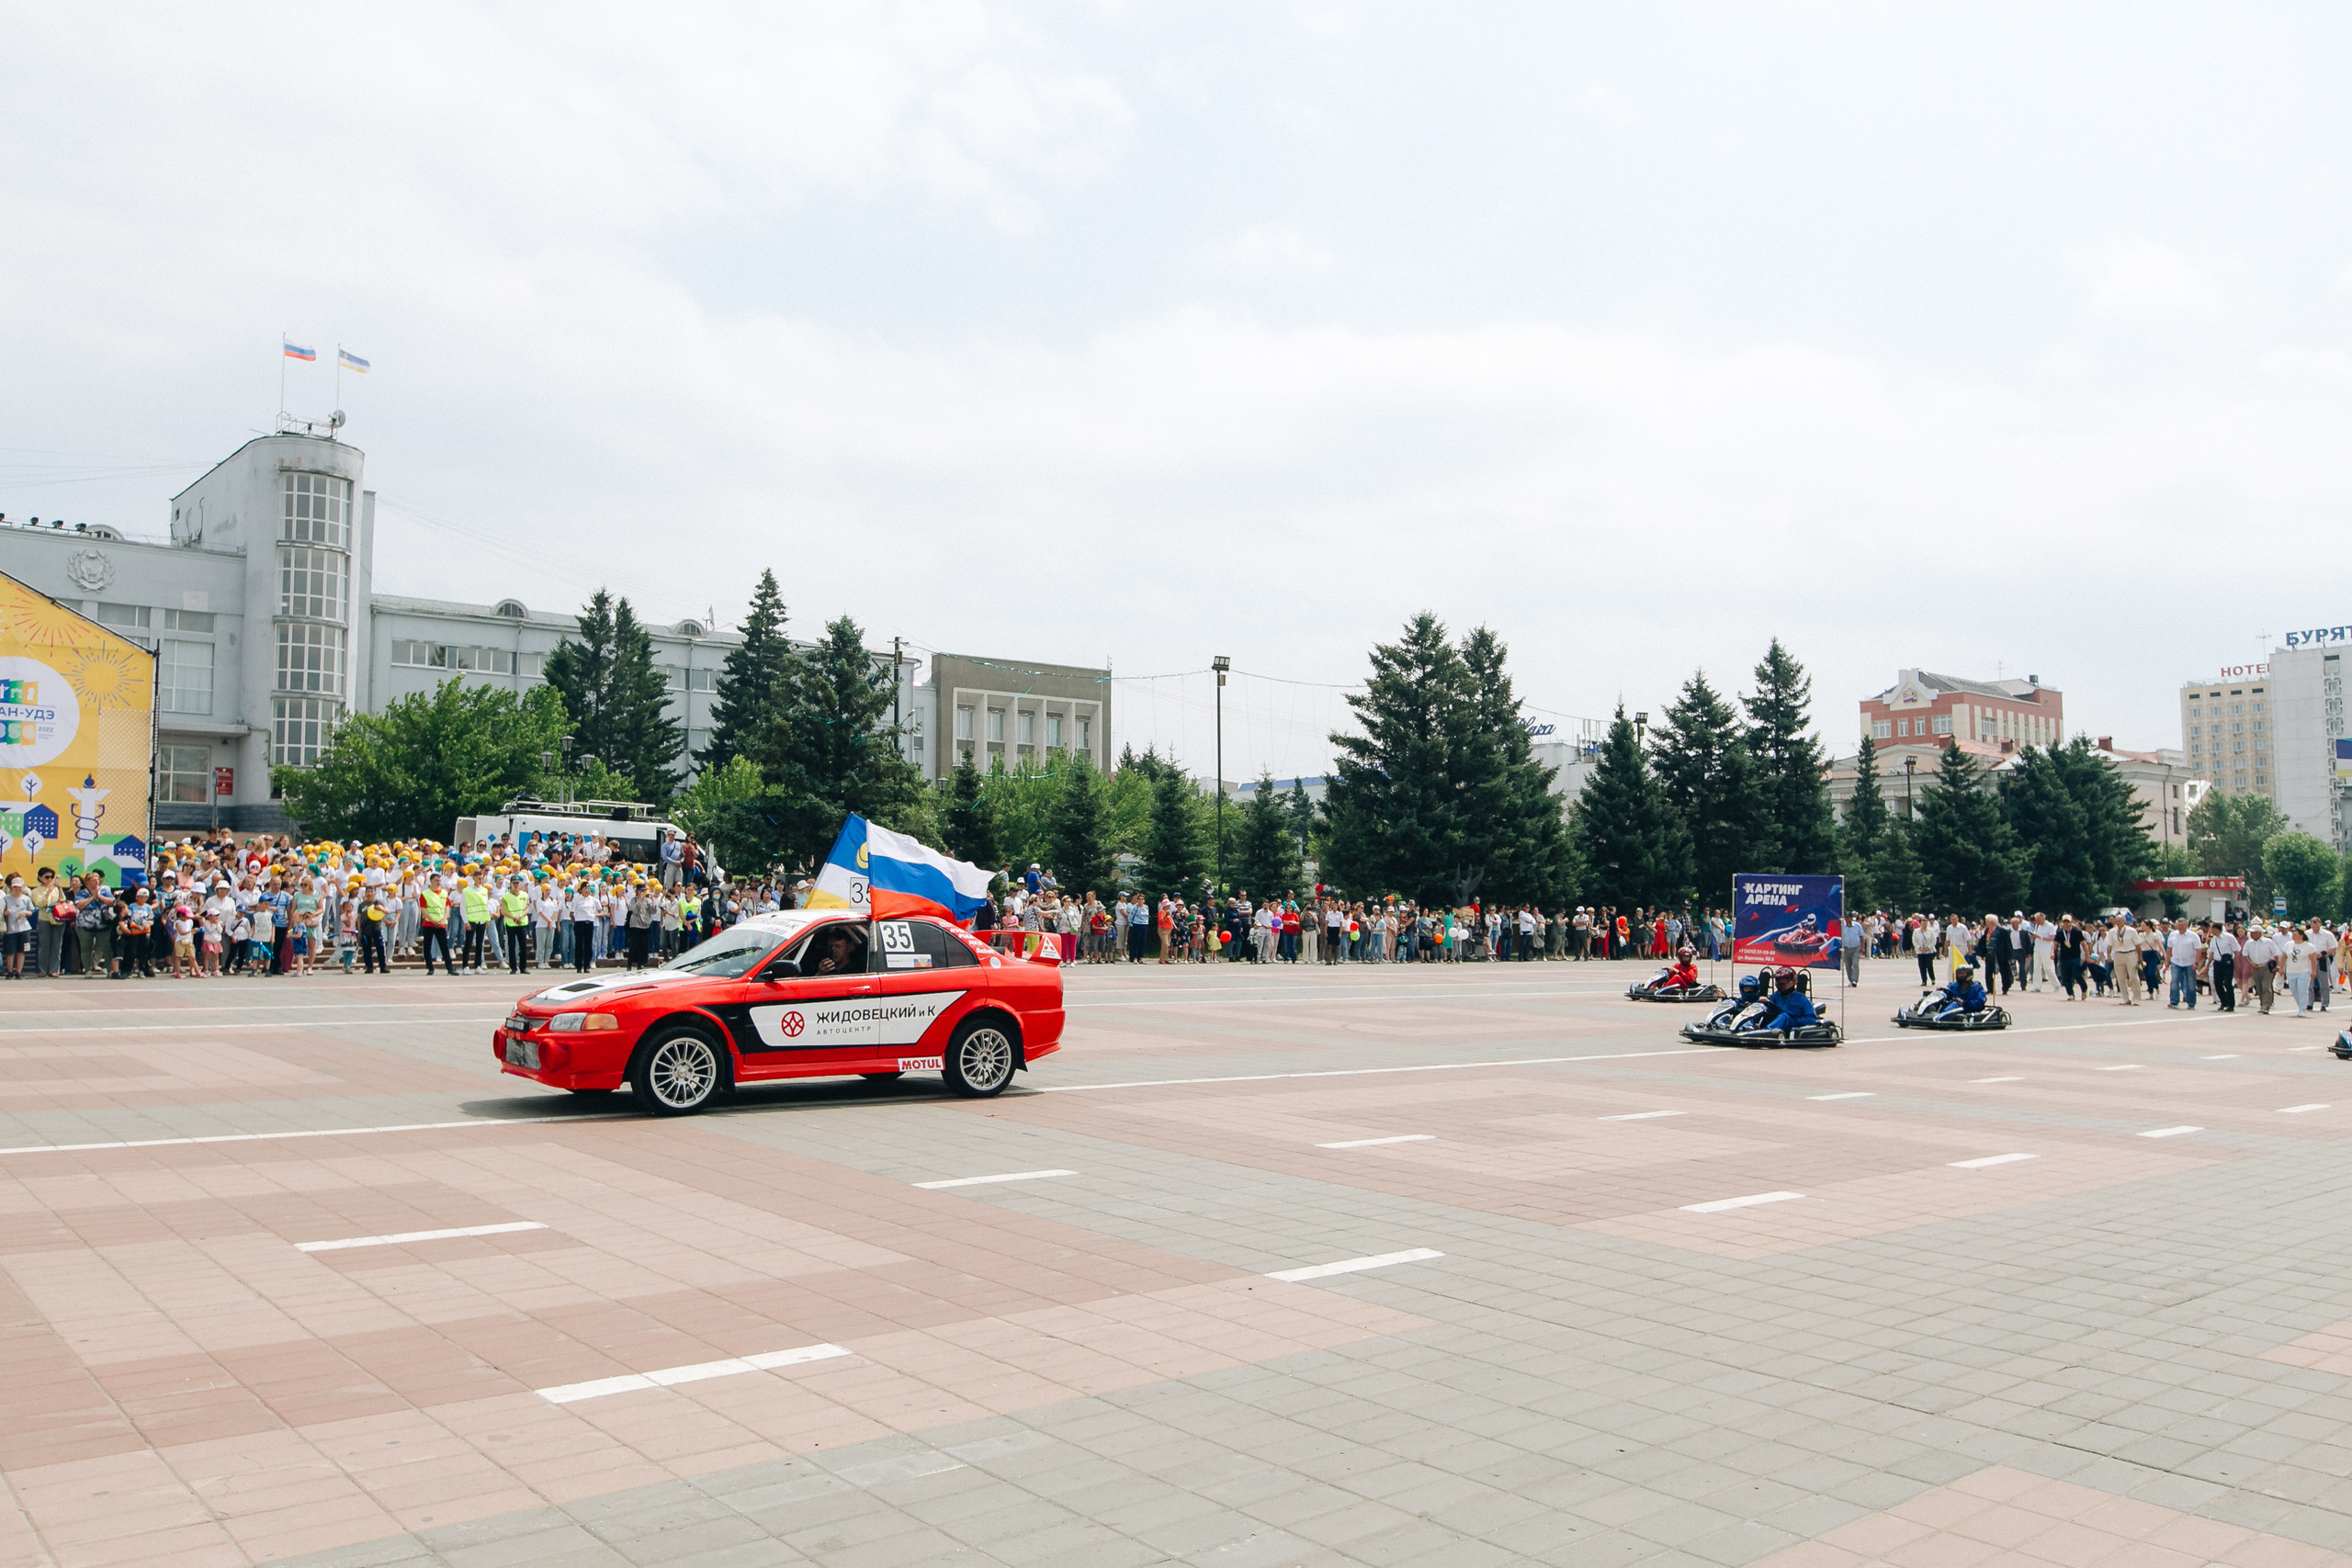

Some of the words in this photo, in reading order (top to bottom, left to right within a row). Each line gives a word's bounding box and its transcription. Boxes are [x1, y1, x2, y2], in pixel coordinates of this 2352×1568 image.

[1743, 883, 1804, 896] КАРТИНГ
[1745, 894, 1788, 906] АРЕНА
[883, 924, 911, 950] 35
[816, 1004, 917, 1024] ЖИДОВЕЦКИЙ
[927, 1005, 936, 1017] К
[816, 1026, 872, 1036] АВТОЦЕНТР
[901, 1059, 941, 1070] MOTUL
